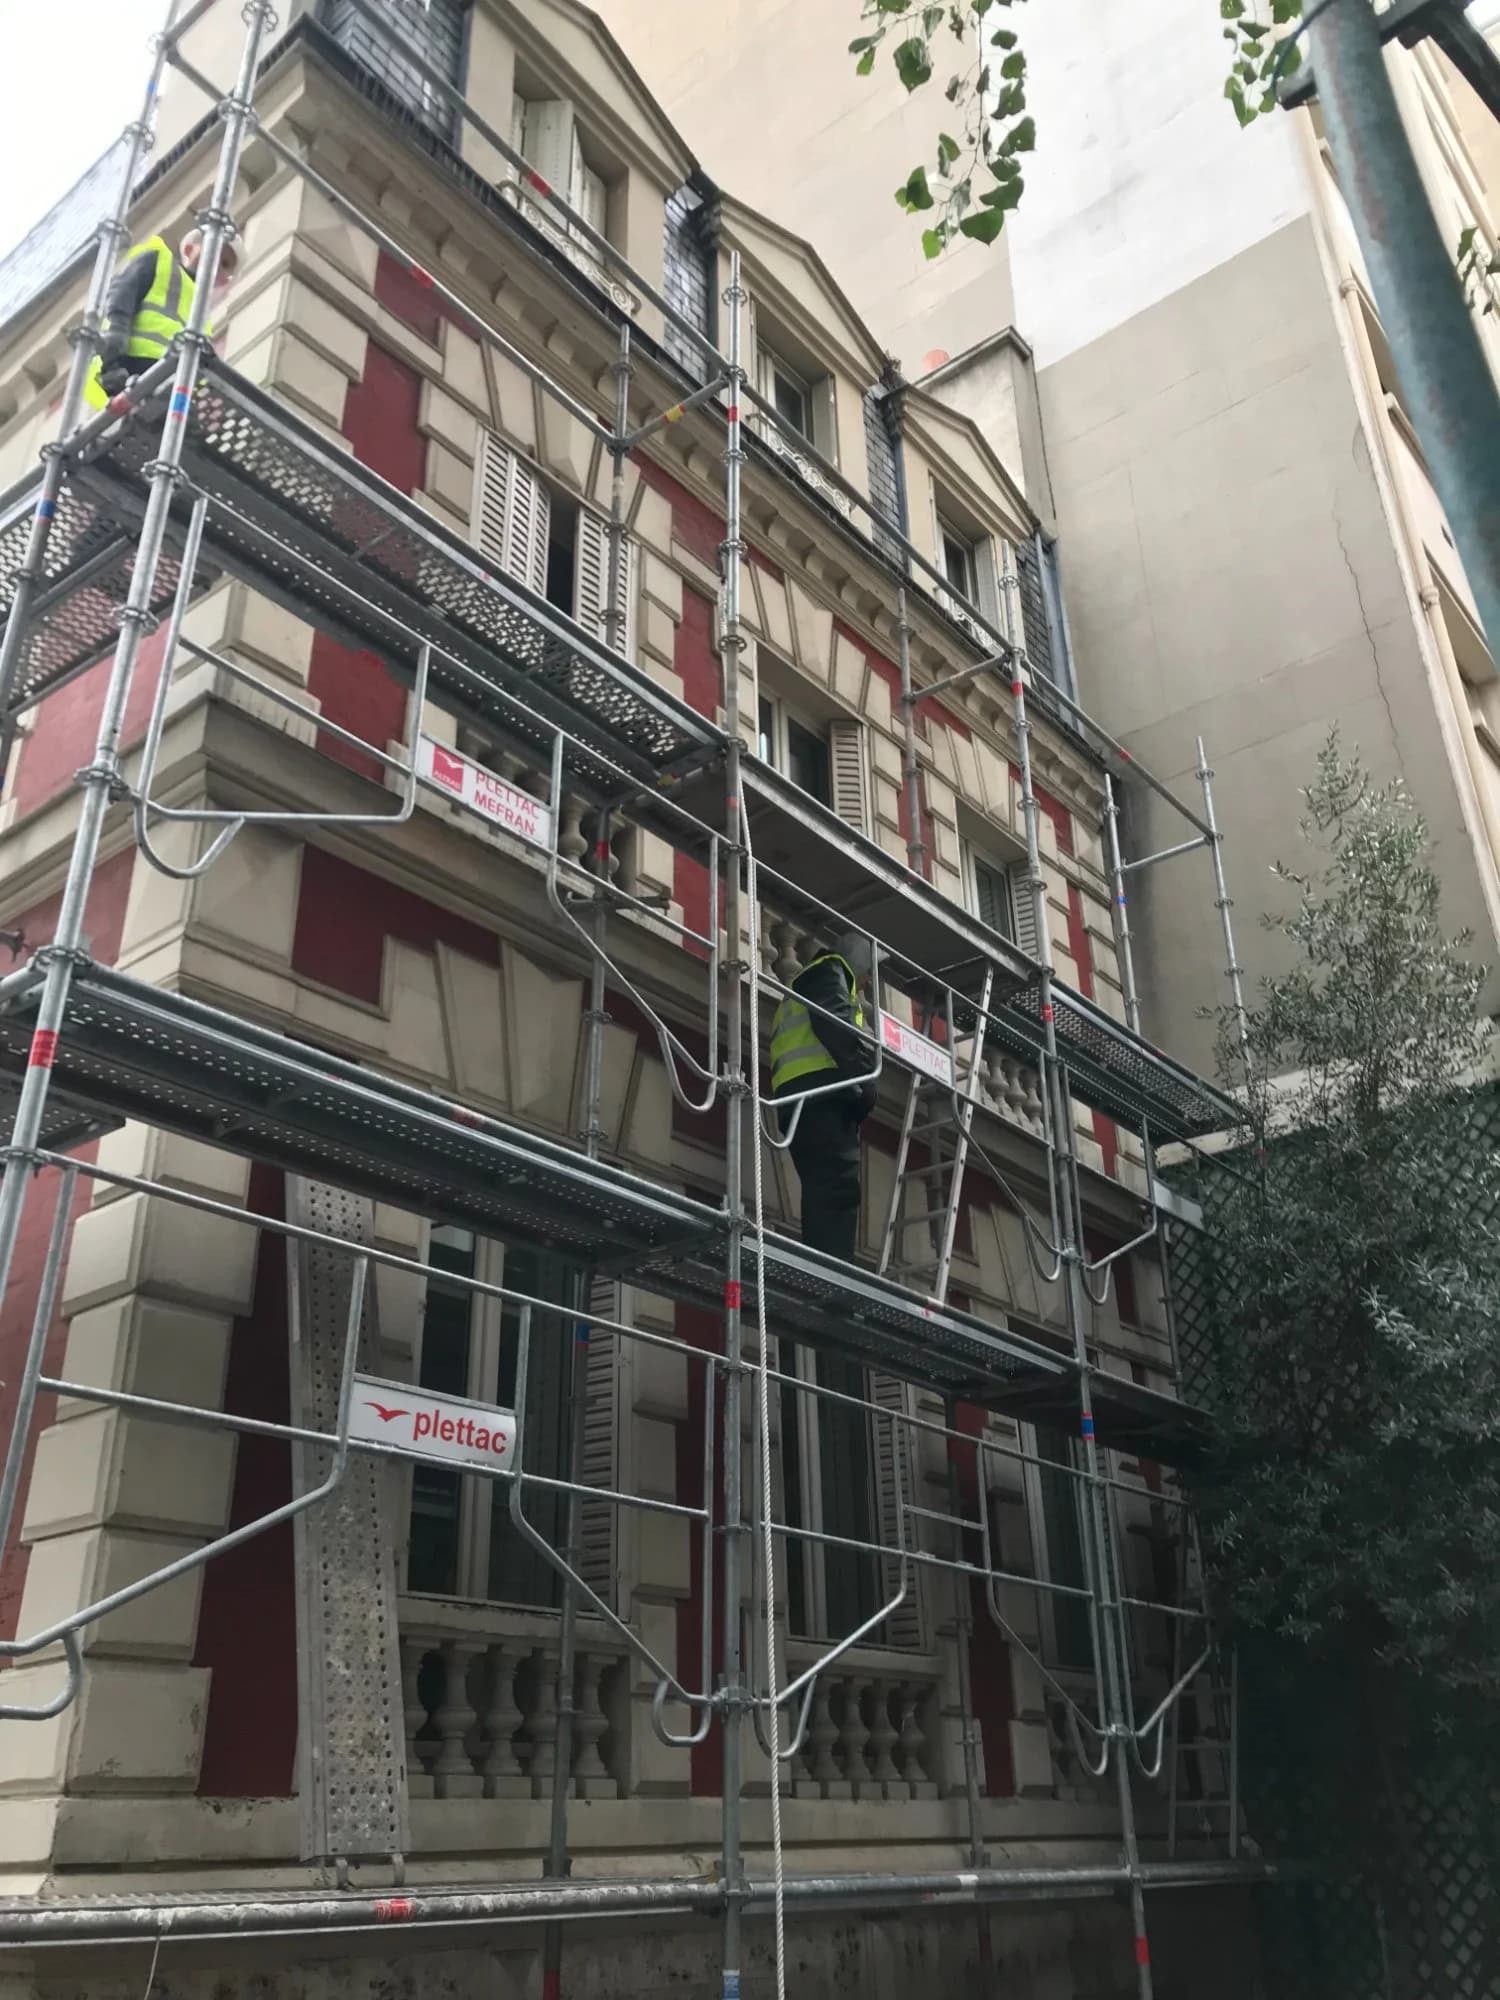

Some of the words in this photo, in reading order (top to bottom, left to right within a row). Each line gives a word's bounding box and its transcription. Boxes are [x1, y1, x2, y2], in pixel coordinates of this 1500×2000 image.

[474, 790, 536, 836] MEFRAN
[475, 769, 541, 821] PLETTAC
[412, 1409, 507, 1455] plettac
